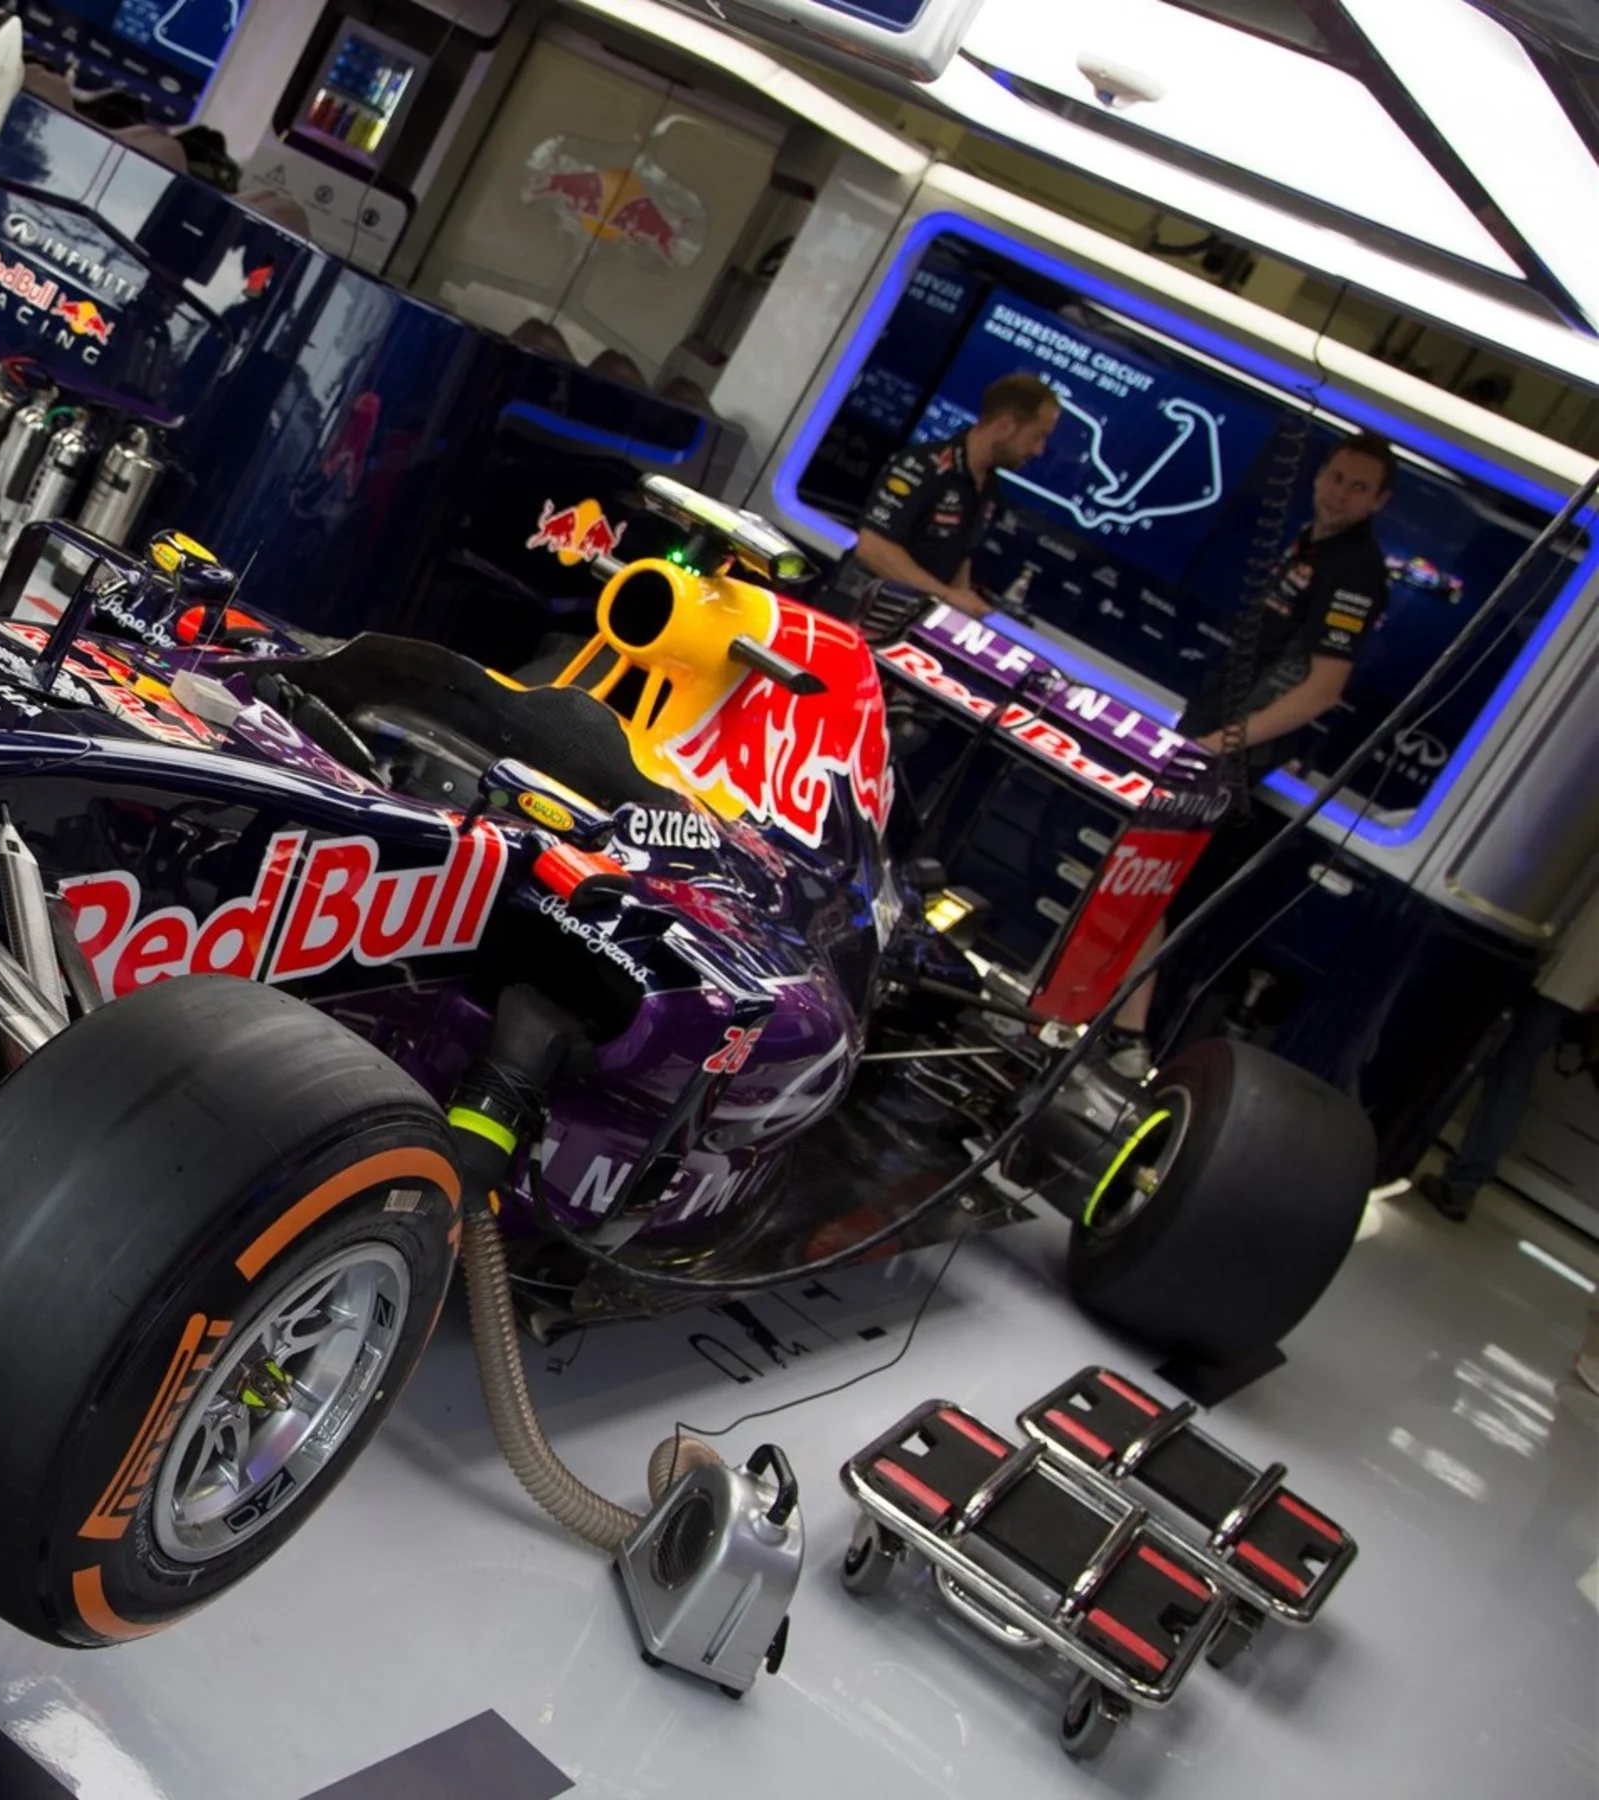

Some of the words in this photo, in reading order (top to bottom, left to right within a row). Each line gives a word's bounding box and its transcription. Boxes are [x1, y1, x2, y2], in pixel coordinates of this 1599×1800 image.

[41, 238, 138, 301] INFINITI
[992, 304, 1093, 364] SILVERSTONE
[1089, 352, 1155, 393] CIRCUIT
[629, 807, 722, 850] exness
[1098, 845, 1183, 896] TOTAL
[539, 894, 593, 941] Pepe
[586, 931, 656, 983] Jeans
[702, 1024, 763, 1074] 26
[77, 1312, 235, 1540] PIRELLI
